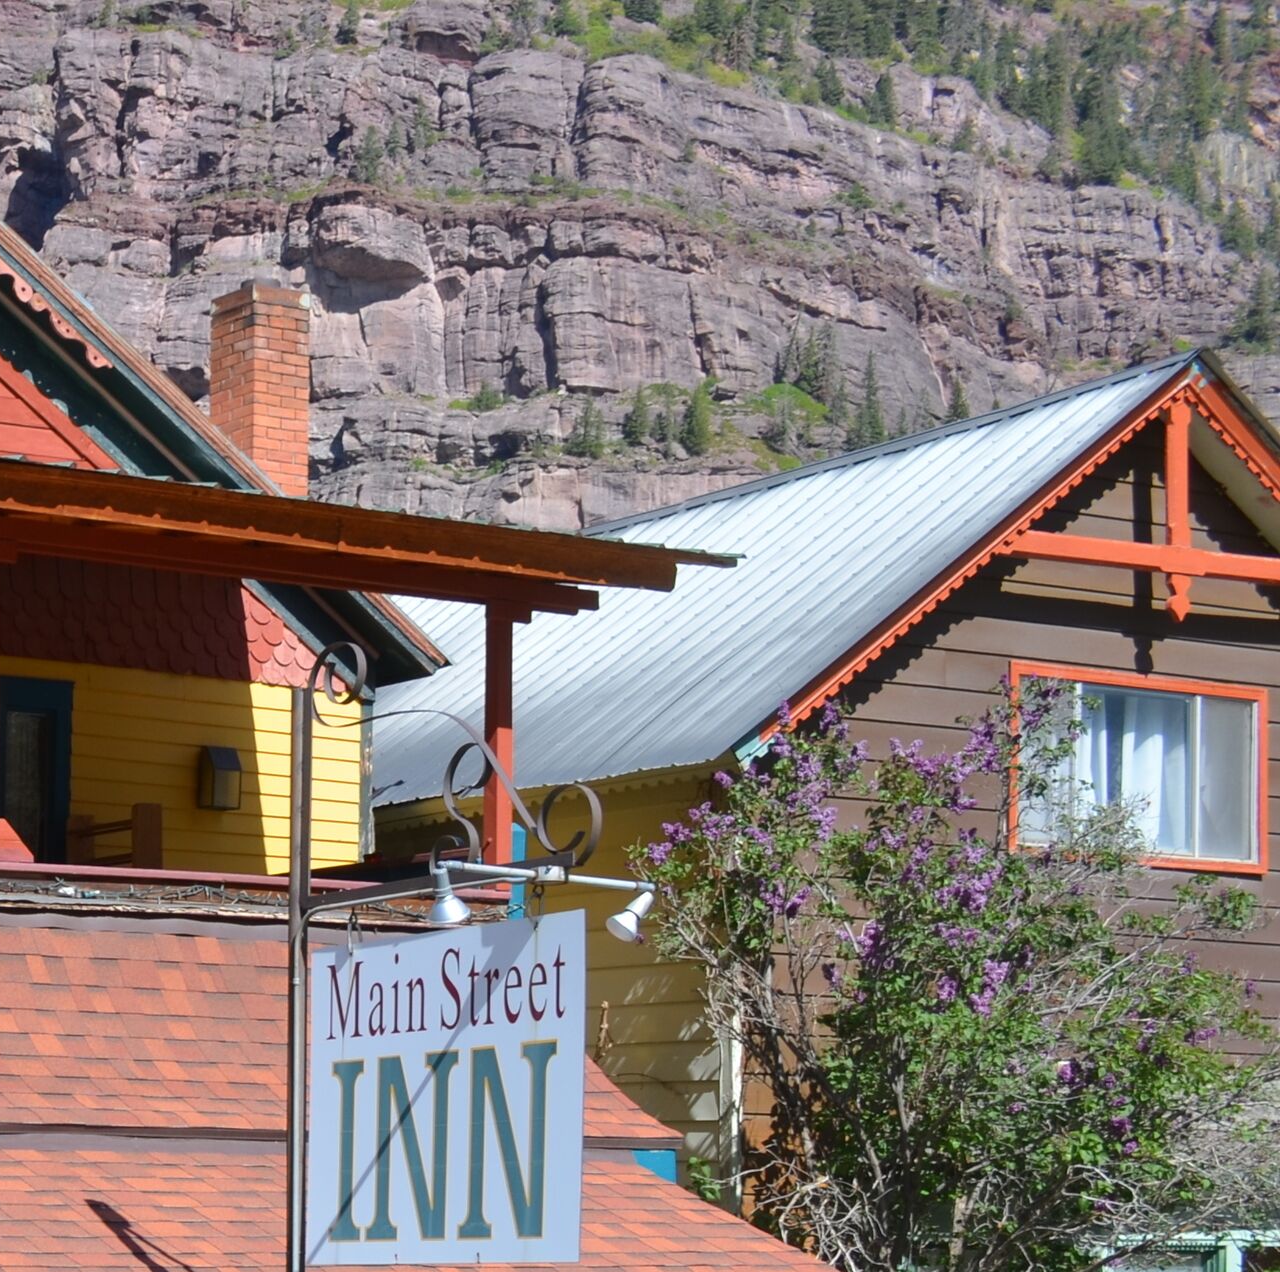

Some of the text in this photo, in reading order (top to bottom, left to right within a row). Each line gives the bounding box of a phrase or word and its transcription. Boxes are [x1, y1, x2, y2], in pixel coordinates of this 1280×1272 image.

[325, 943, 566, 1041] Main Street
[327, 1038, 558, 1242] INN
